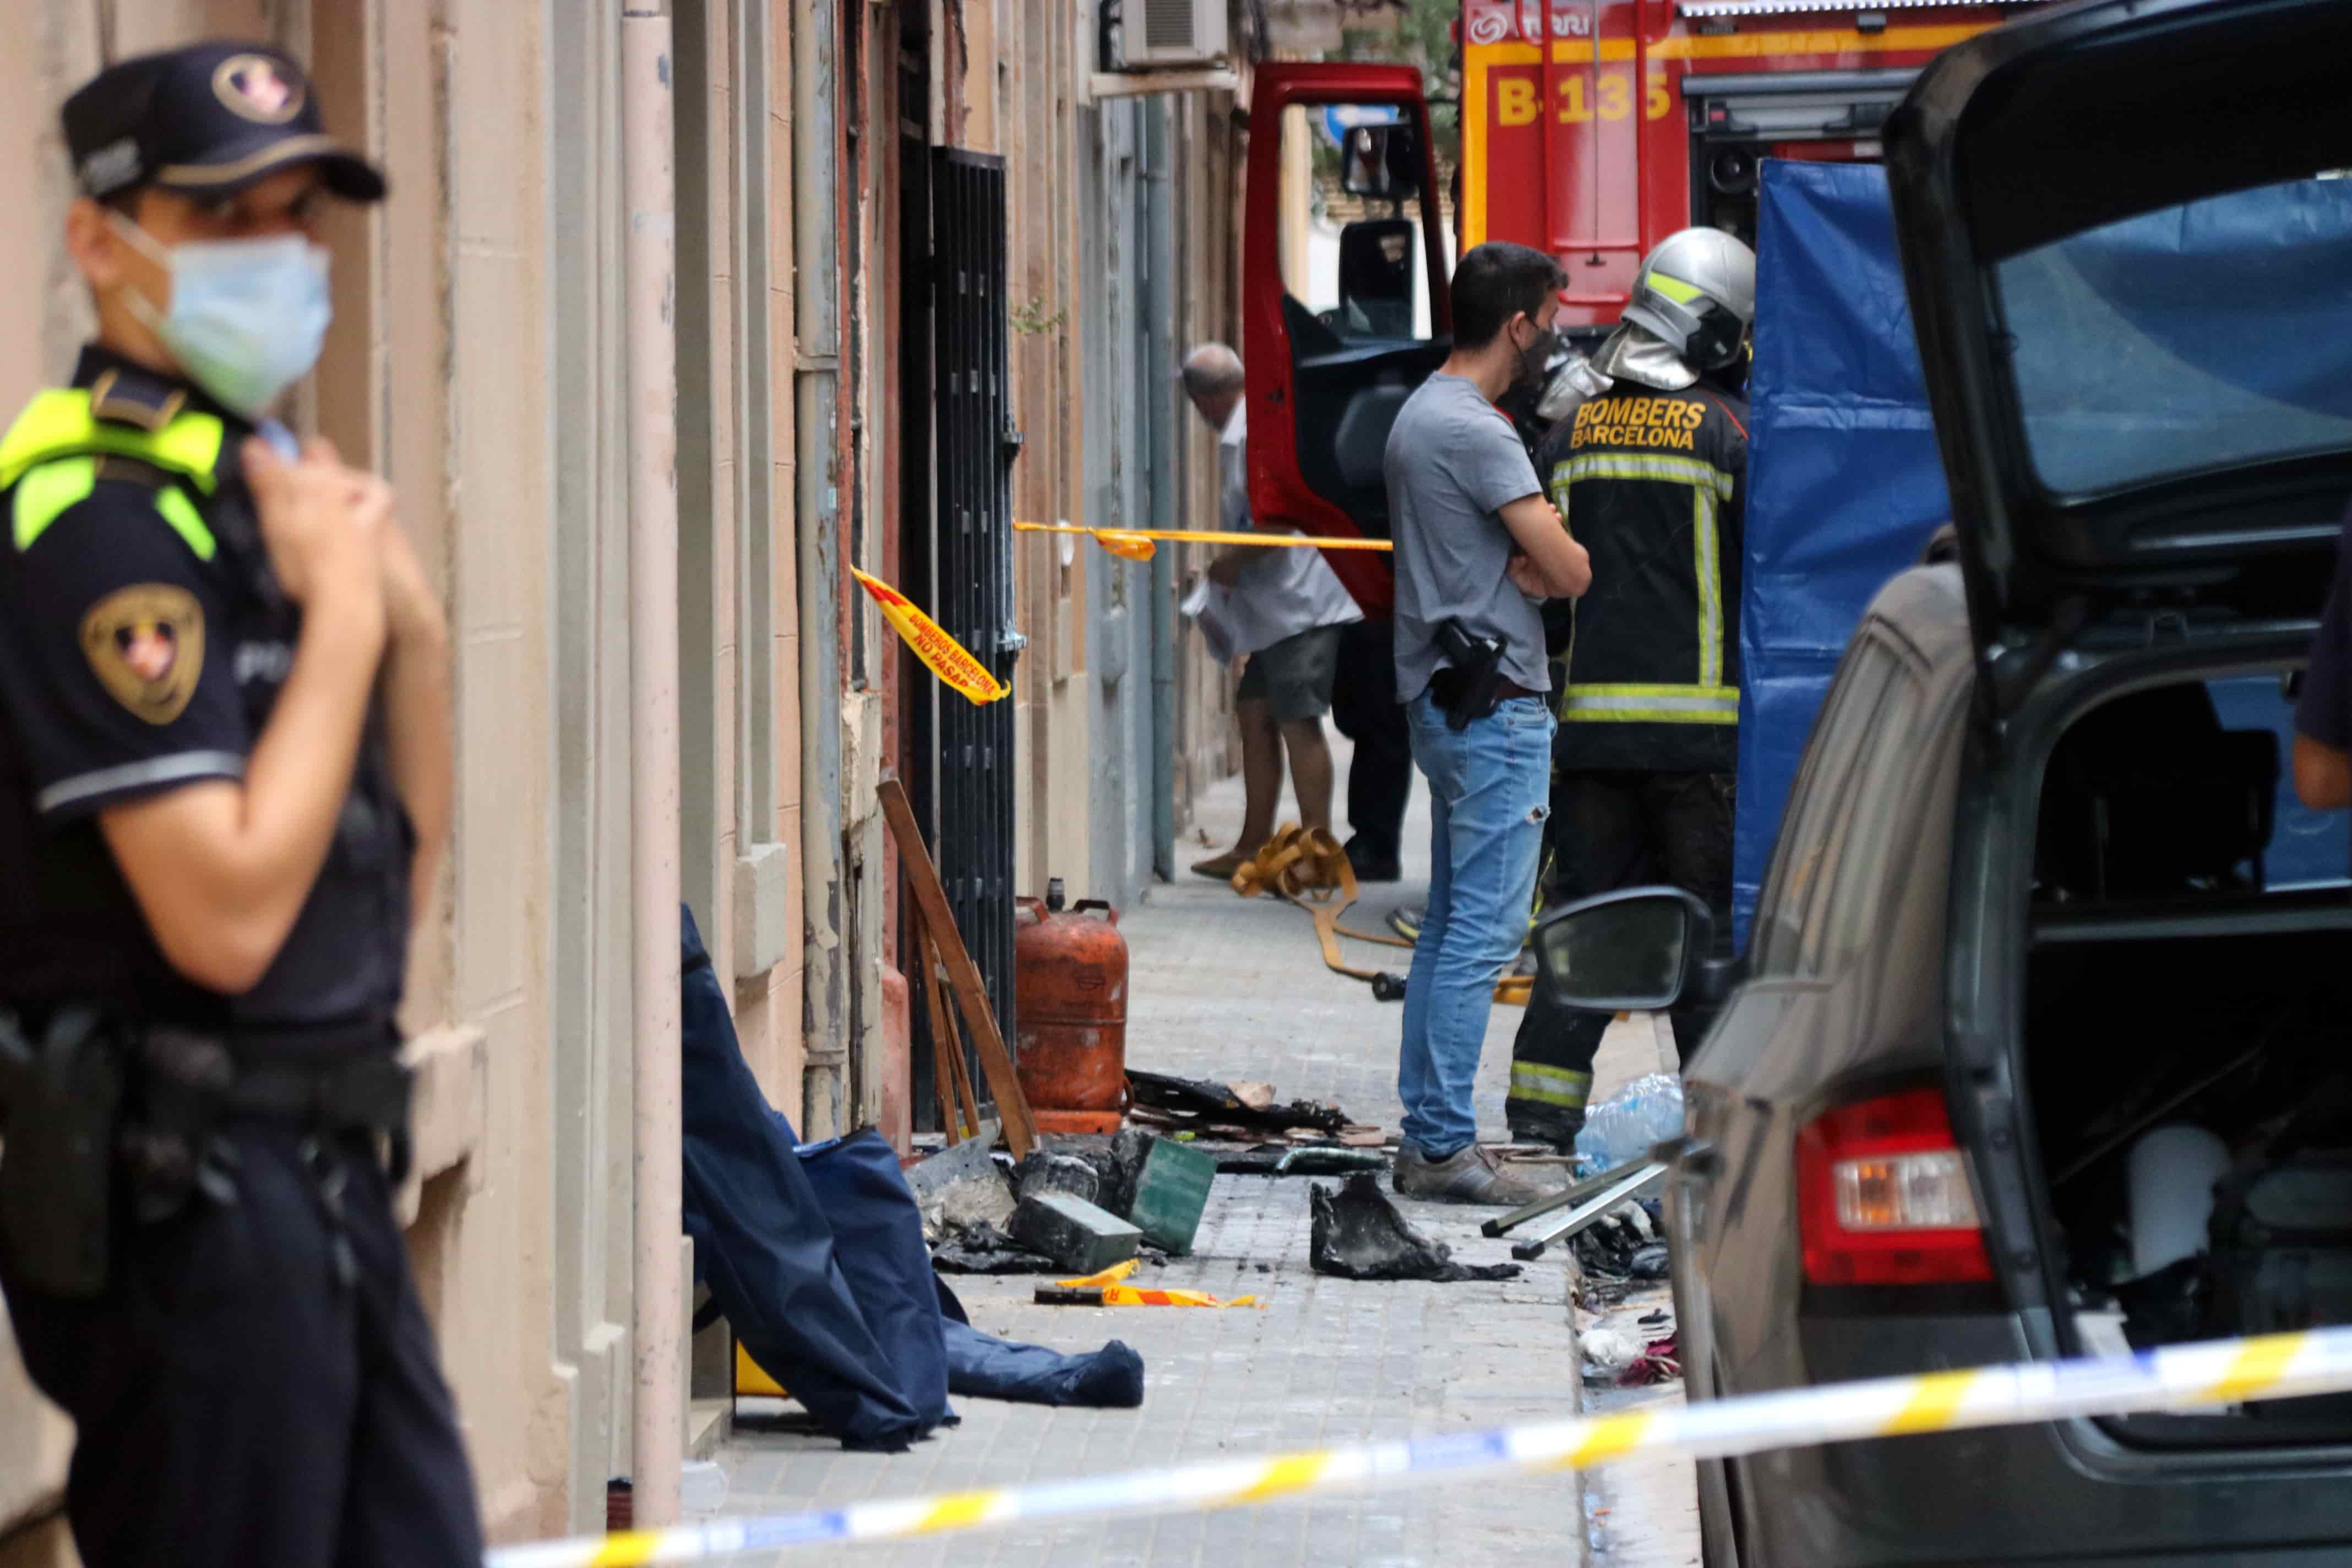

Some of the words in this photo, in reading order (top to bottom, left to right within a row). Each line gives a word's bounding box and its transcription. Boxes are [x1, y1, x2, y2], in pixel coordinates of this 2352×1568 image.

[1574, 396, 1706, 429] BOMBERS
[1570, 425, 1694, 450] BARCELONA
[909, 613, 952, 654] BOMBEROS
[949, 650, 995, 695] BARCELONA
[913, 634, 933, 653] NO
